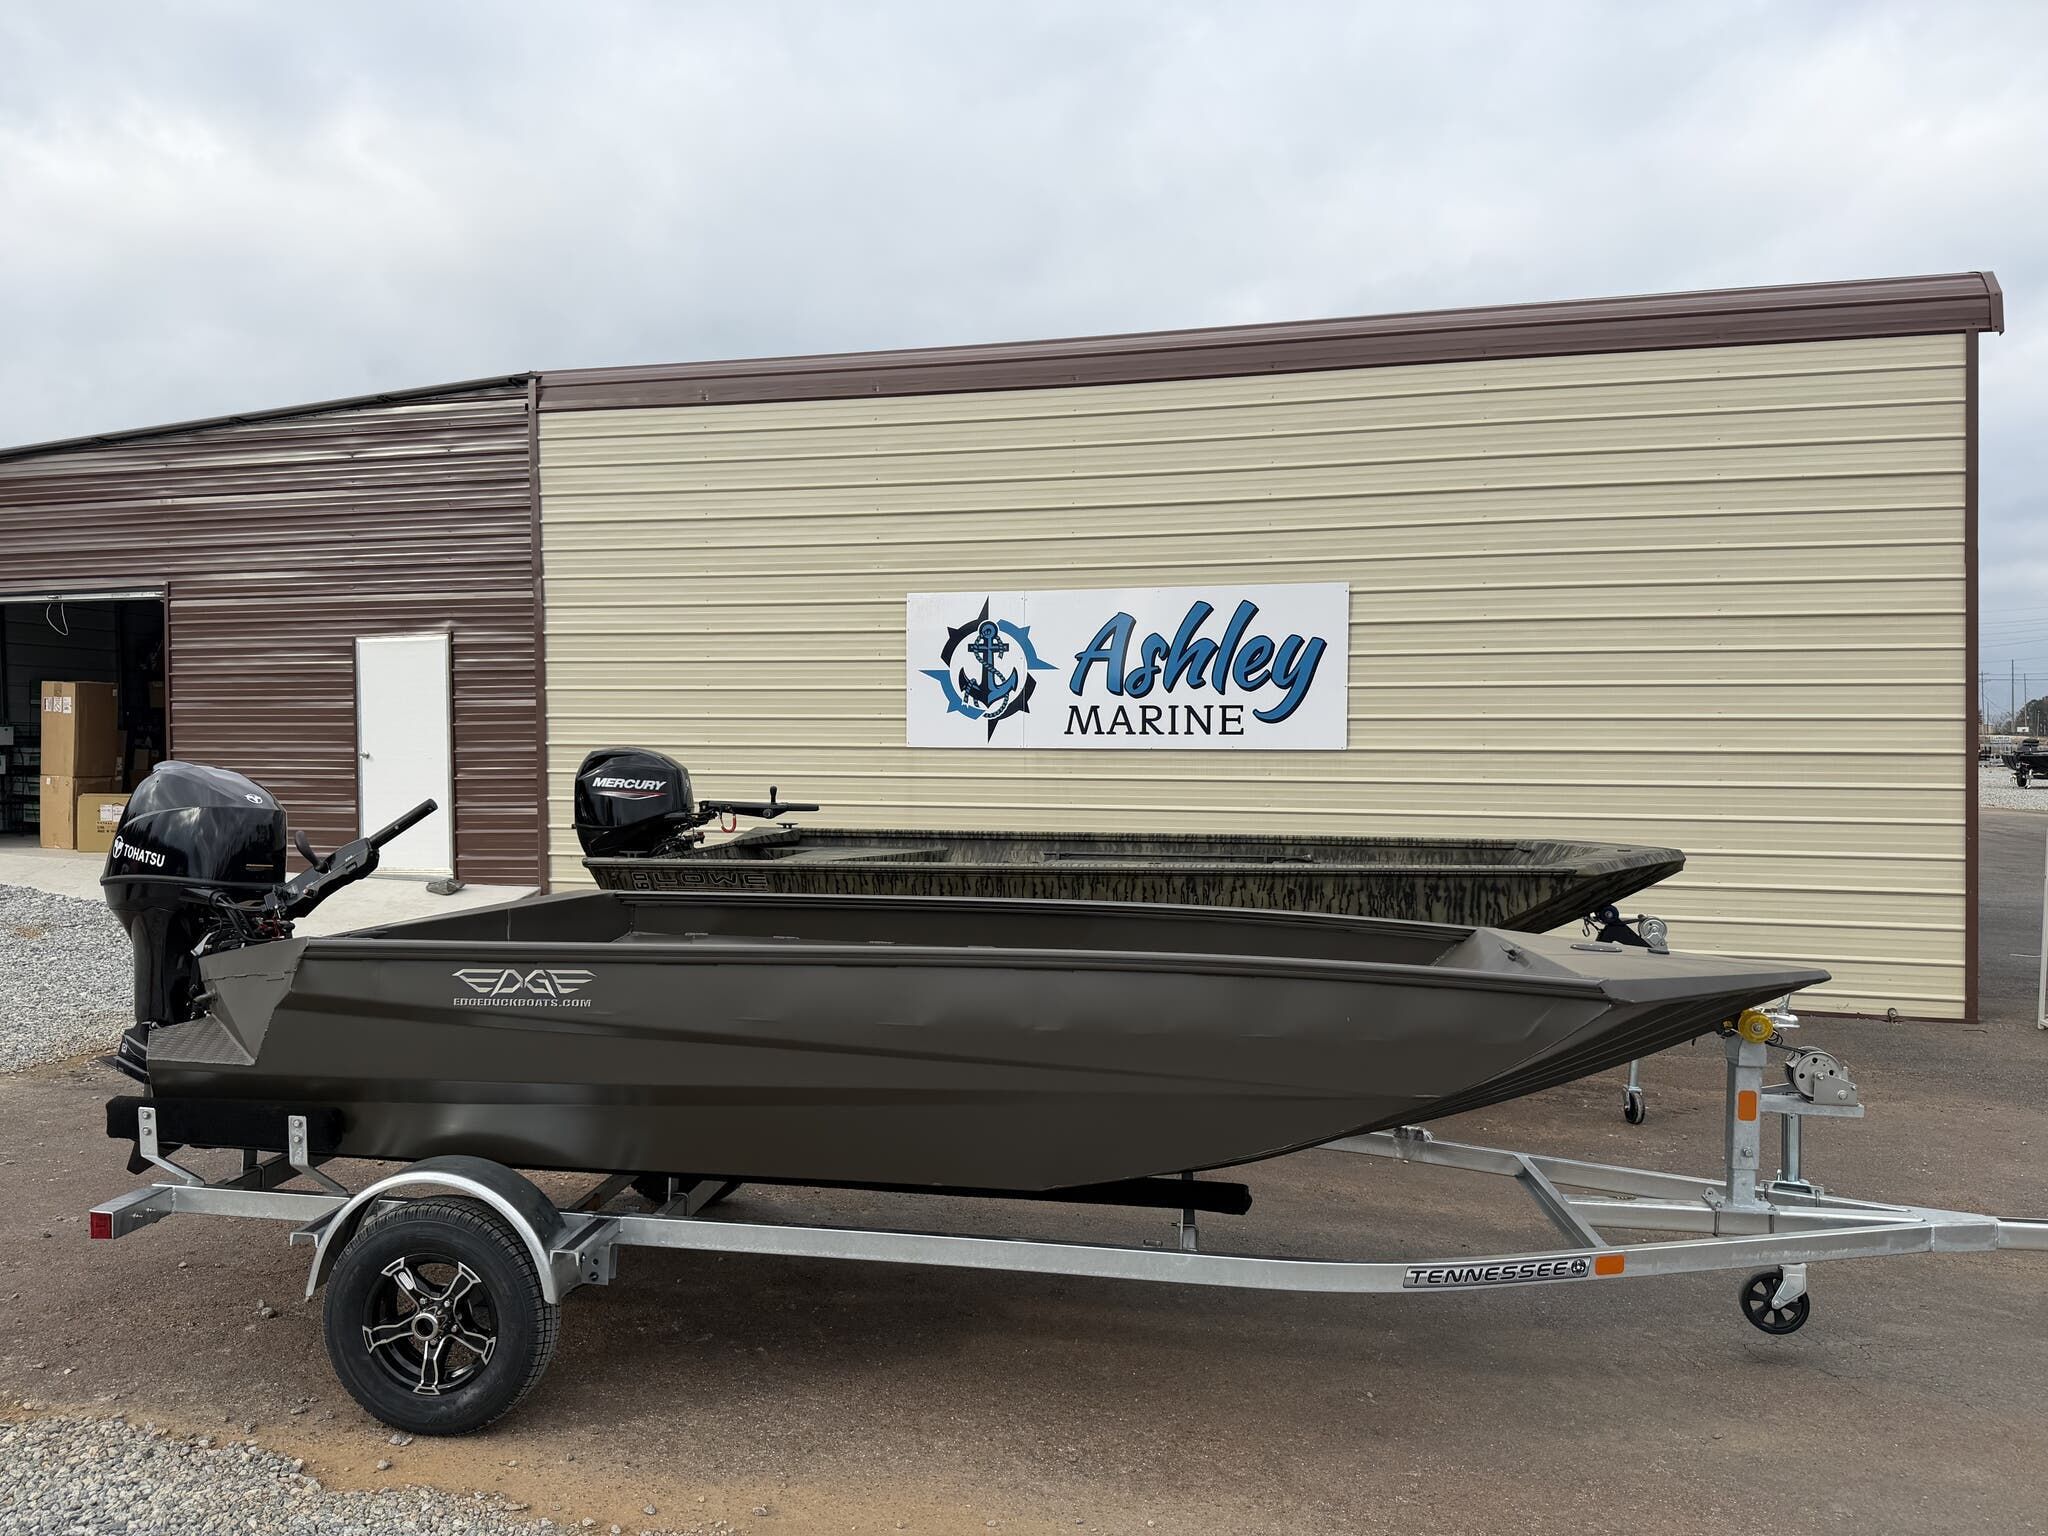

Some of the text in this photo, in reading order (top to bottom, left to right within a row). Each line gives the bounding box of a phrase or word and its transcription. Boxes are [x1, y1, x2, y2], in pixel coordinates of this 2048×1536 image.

[1069, 599, 1328, 723] Ashley
[1064, 704, 1245, 735] MARINE
[592, 777, 667, 791] MERCURY
[123, 844, 166, 868] TOHATSU
[653, 872, 769, 886] LOWE
[452, 968, 597, 998] EDGE
[453, 997, 592, 1008] EDGEDUCKBOATS.COM
[1410, 1261, 1569, 1285] TENNESSEE
